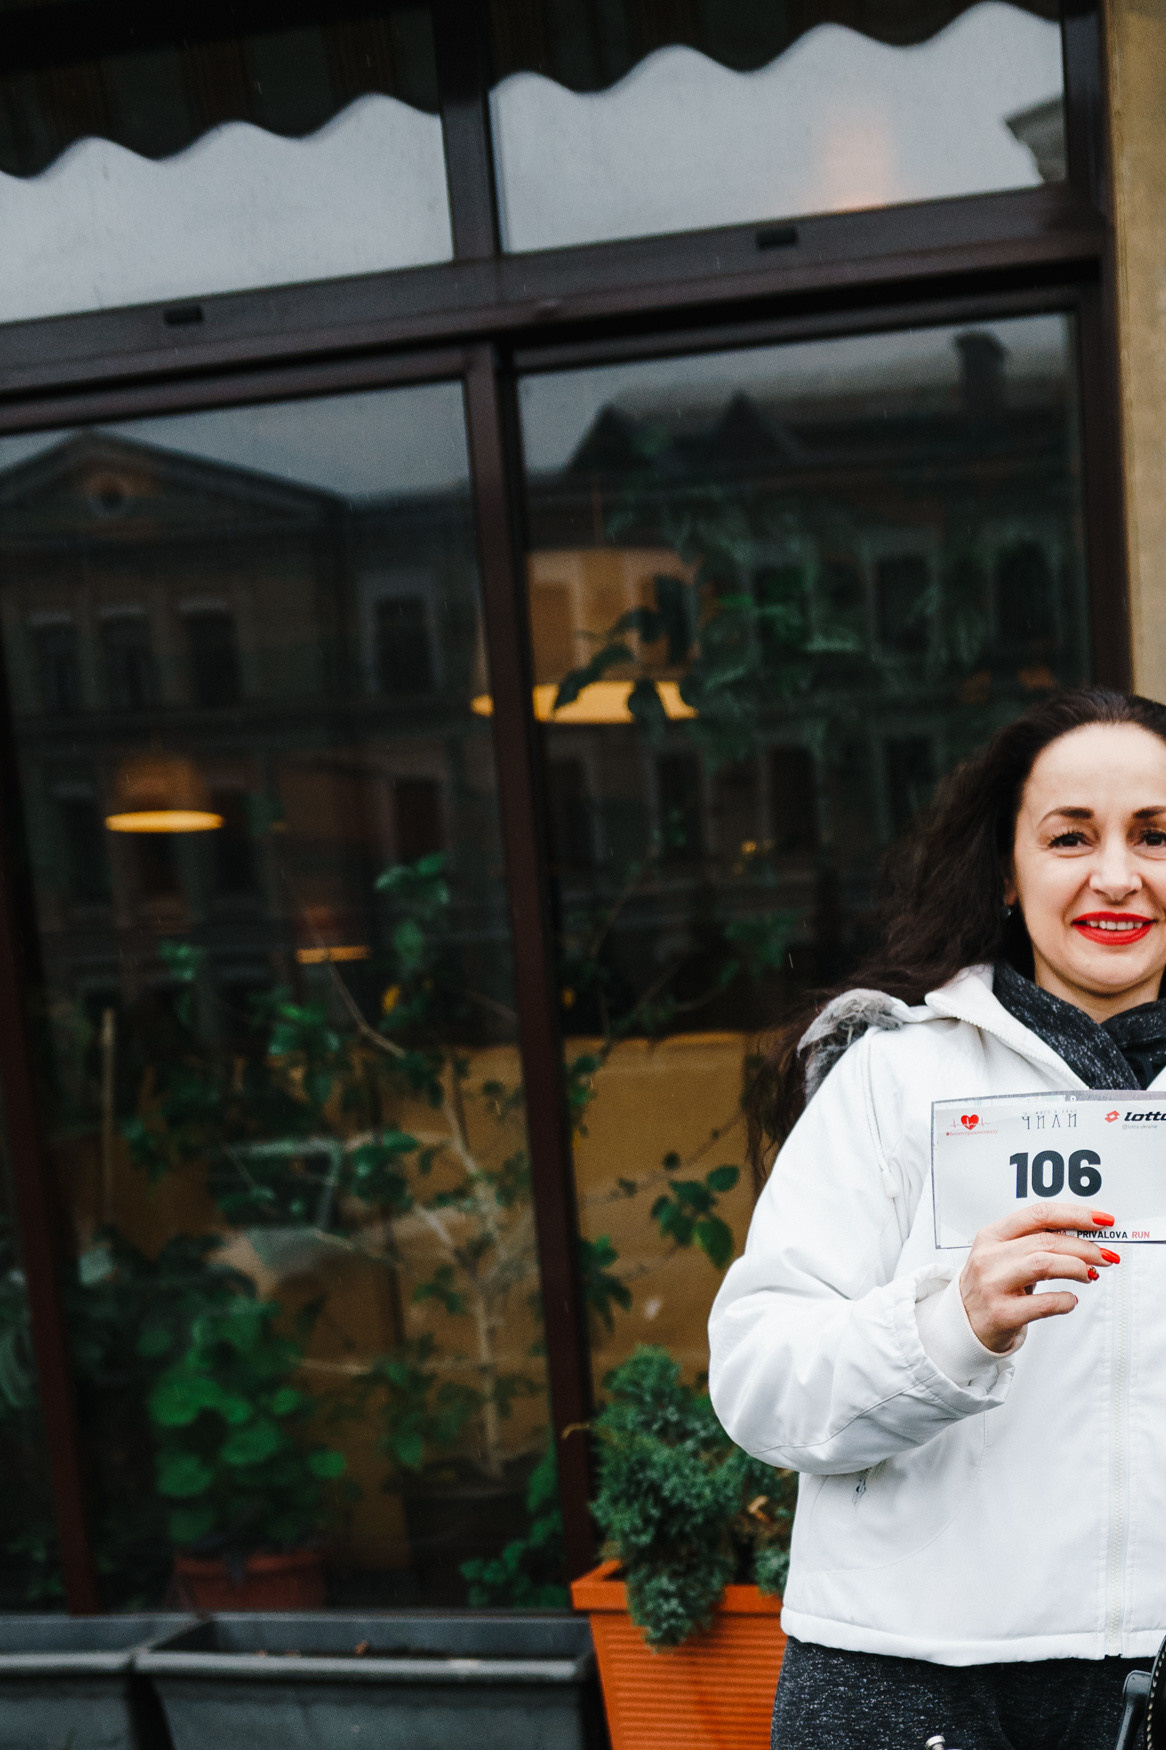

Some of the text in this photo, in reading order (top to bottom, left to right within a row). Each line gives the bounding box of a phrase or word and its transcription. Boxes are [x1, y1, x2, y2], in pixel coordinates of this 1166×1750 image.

[1021, 1112, 1078, 1131] ЧИЛИ
[1009, 1149, 1102, 1199] 106
[1077, 1230, 1128, 1239] PRIVALOVA
[1131, 1230, 1150, 1239] RUN
